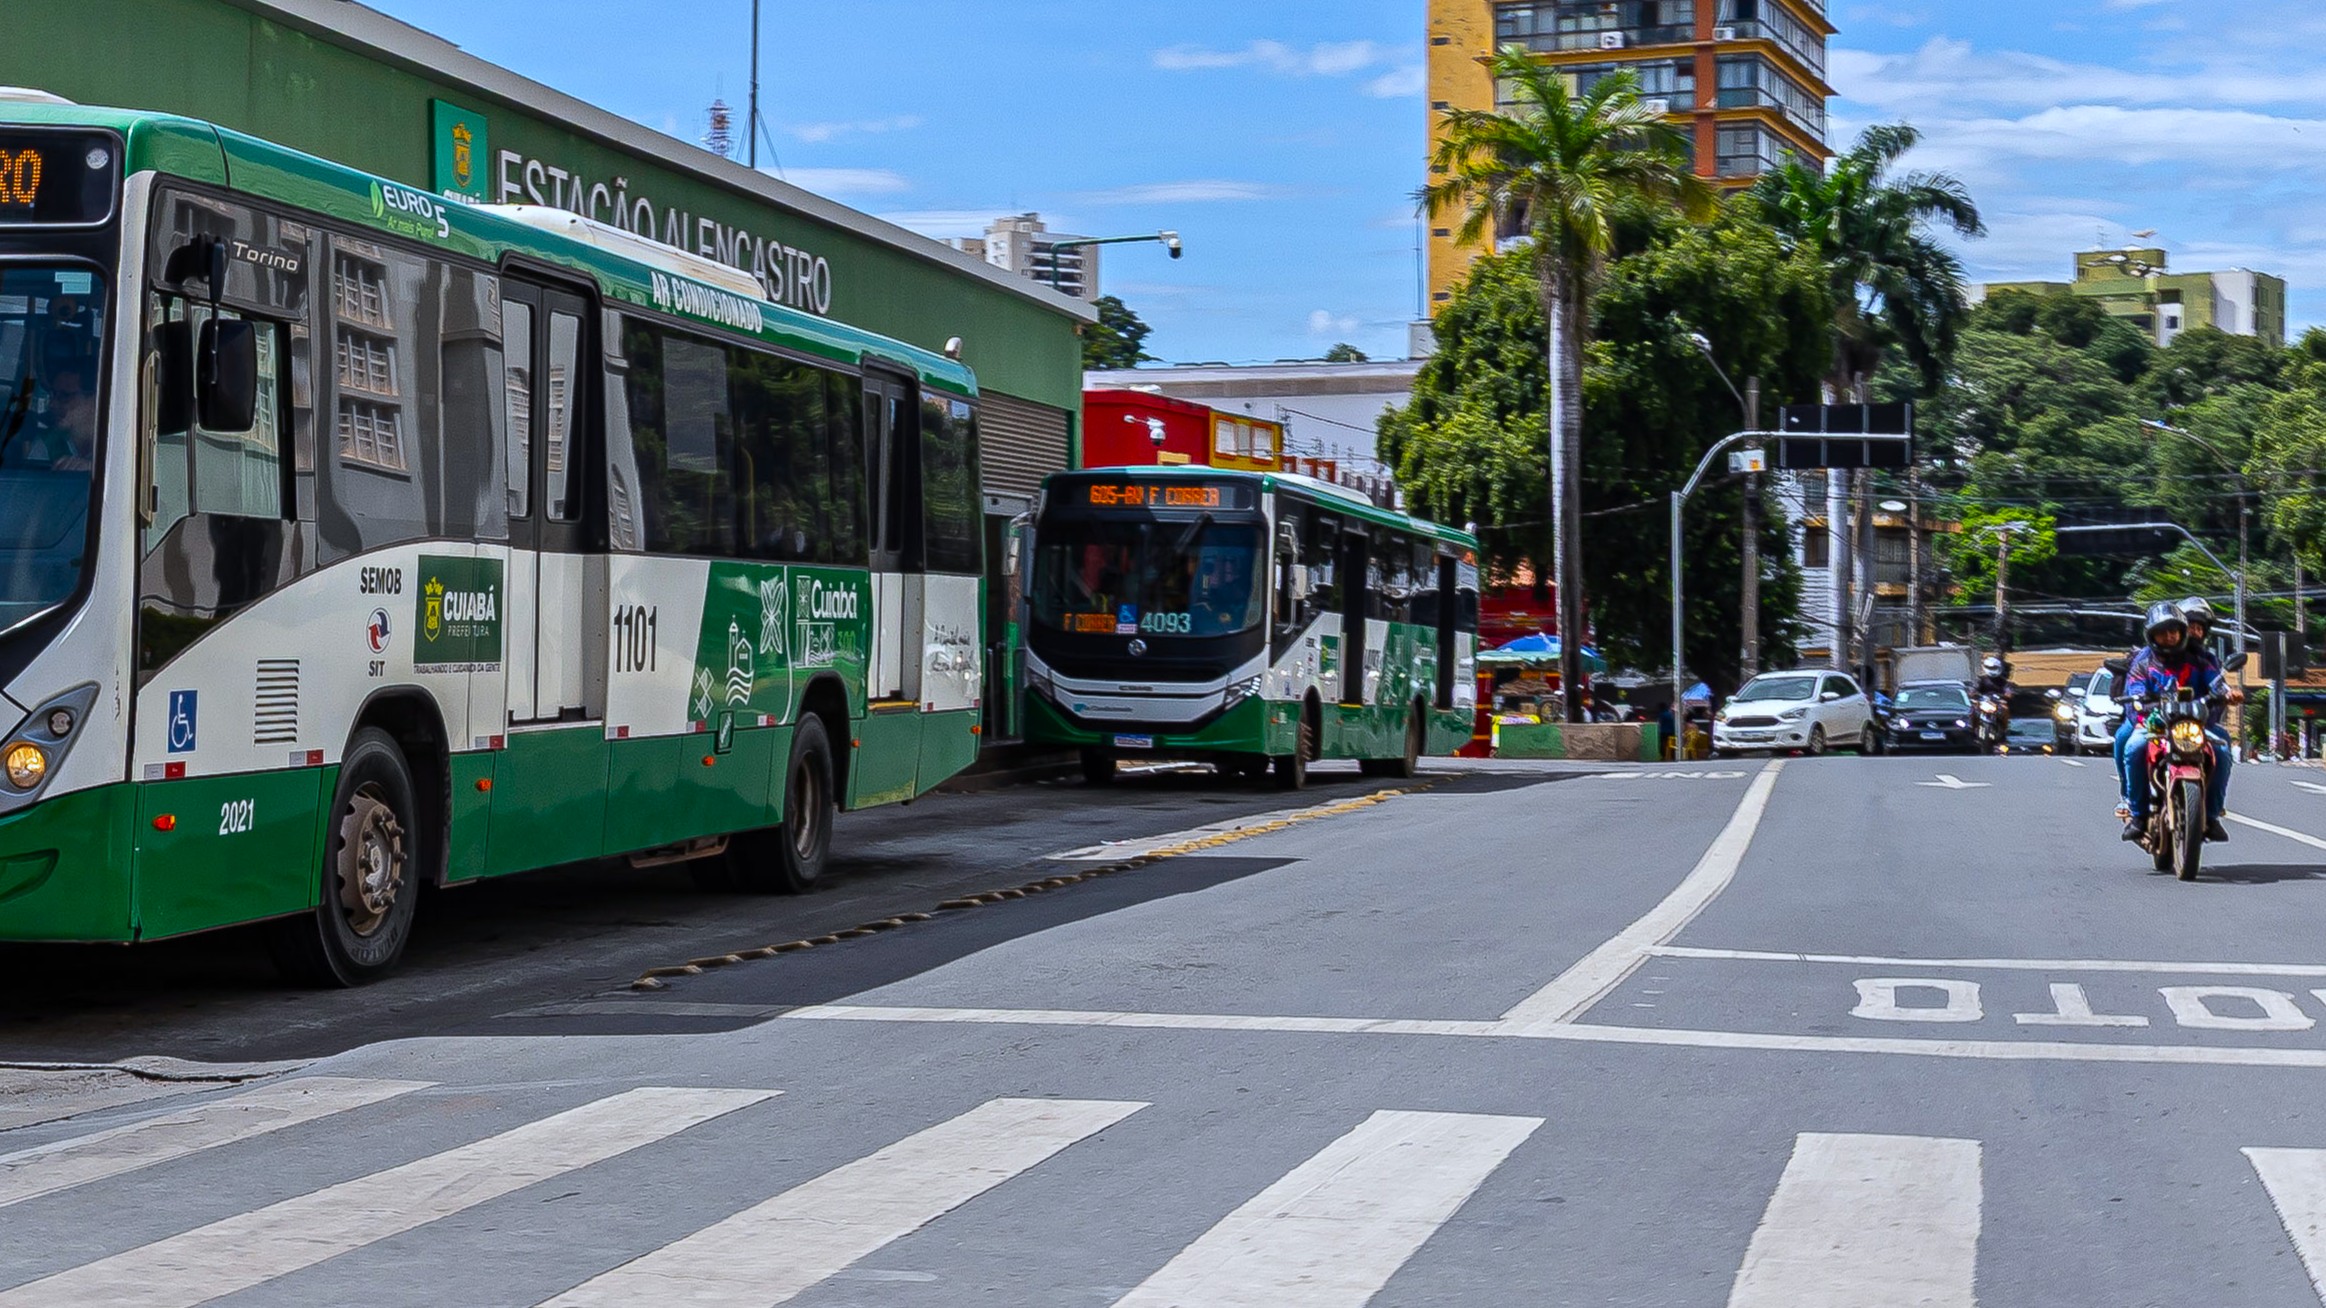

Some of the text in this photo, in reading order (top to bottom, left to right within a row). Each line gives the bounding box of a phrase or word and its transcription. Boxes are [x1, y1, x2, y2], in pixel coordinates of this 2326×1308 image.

[383, 185, 433, 219] EURO
[434, 205, 450, 238] 5
[233, 242, 298, 271] Torino
[650, 271, 763, 334] AR CONDICIONADO
[360, 566, 402, 594] SEMOB
[444, 584, 496, 621] CUIABÁ
[811, 579, 858, 619] Cuiabá
[614, 604, 657, 672] 1101
[1140, 612, 1192, 633] 4093
[368, 660, 386, 677] SIT
[219, 798, 254, 835] 2021
[1848, 977, 2326, 1031] OTO
